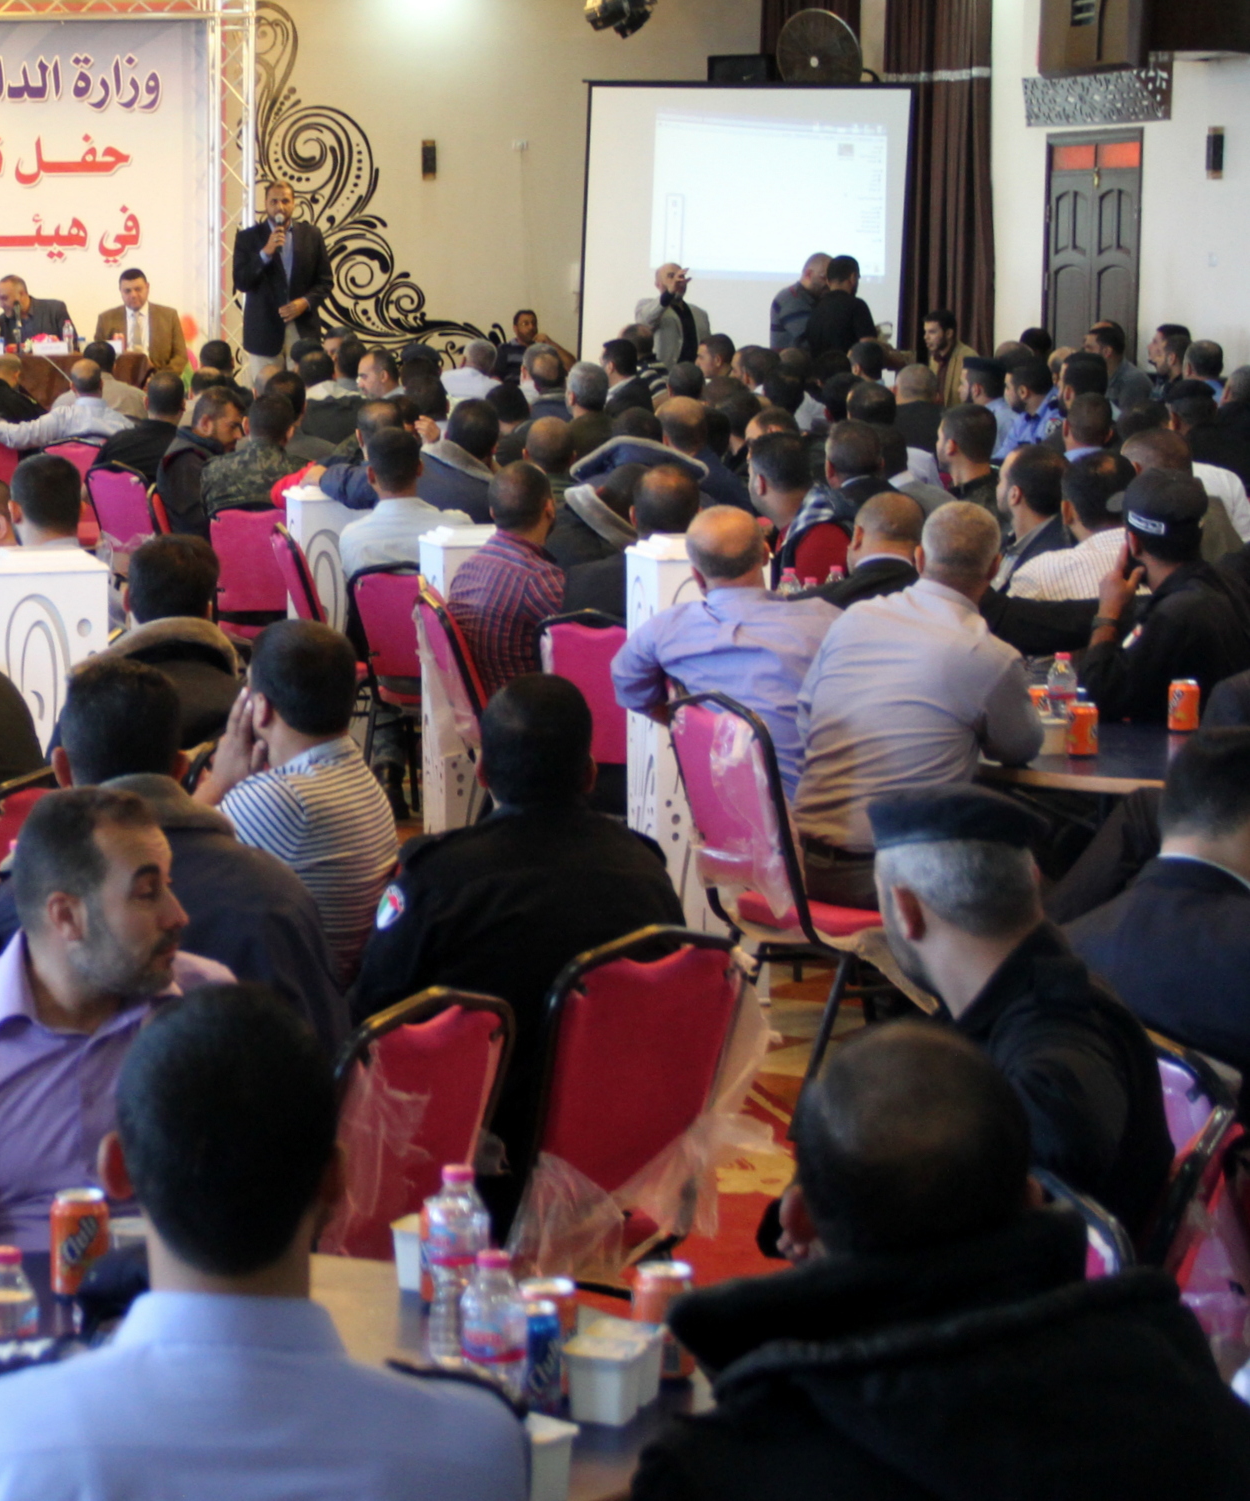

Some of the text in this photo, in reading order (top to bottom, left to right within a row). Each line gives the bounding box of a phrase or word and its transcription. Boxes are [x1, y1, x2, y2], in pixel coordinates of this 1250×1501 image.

[72, 55, 161, 110] وزارة
[14, 132, 132, 187] حفل
[97, 205, 142, 265] في
